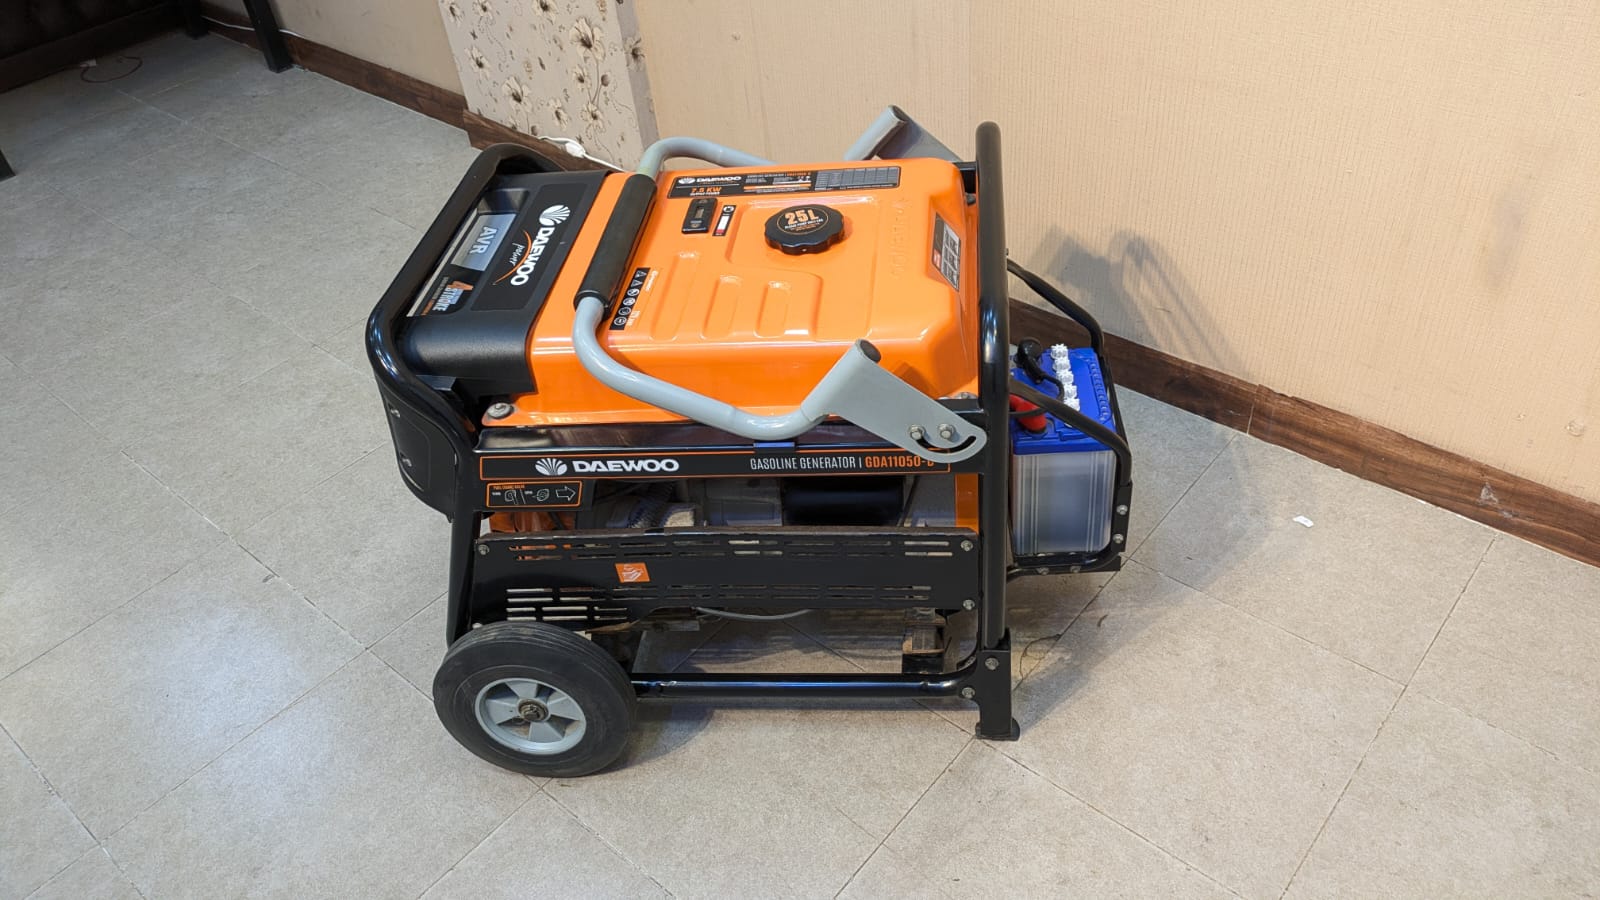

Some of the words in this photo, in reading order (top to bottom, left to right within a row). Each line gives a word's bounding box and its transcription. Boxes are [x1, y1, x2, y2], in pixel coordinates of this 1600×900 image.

[785, 209, 819, 225] 25L
[469, 226, 497, 254] AVR
[510, 227, 555, 286] DAEWOO
[432, 286, 460, 312] STROKE
[572, 458, 680, 472] DAEWOO
[750, 457, 798, 471] GASOLINE
[799, 456, 856, 469] GENERATOR
